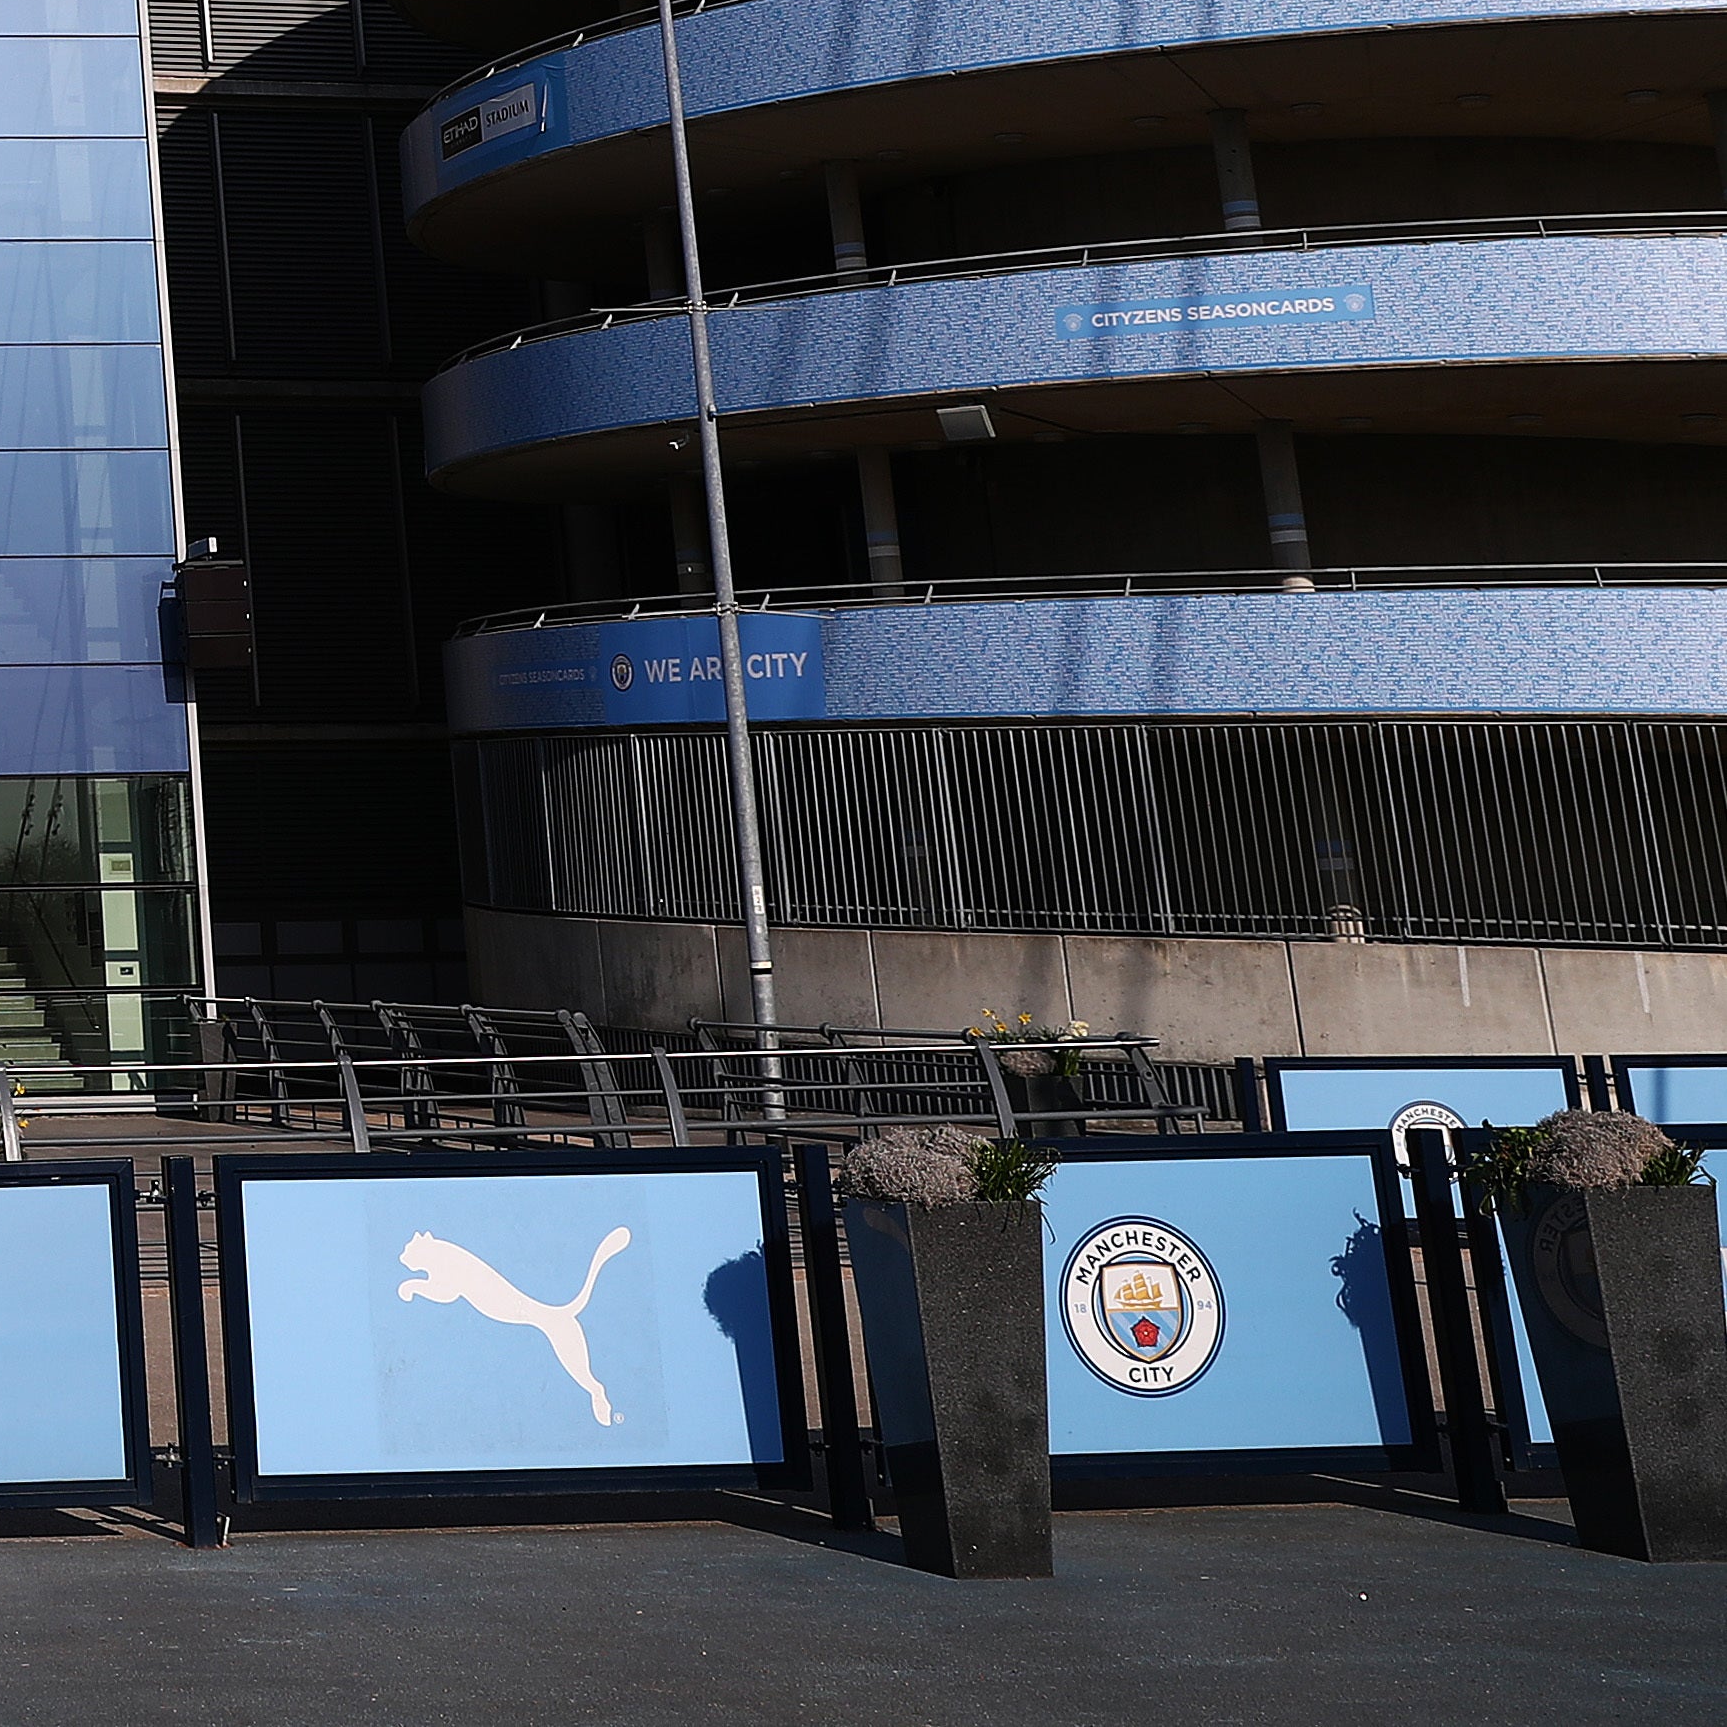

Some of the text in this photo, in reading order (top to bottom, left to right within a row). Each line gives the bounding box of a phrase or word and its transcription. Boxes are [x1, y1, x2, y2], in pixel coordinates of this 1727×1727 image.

[443, 116, 478, 144] ETIHAD
[486, 99, 530, 127] STADIUM
[1091, 297, 1335, 328] CITYZENS SEASONCARDS
[644, 659, 681, 683] WE
[689, 656, 722, 681] AR
[746, 652, 808, 678] CITY
[1396, 1107, 1460, 1133] MANCHESTE
[1076, 1230, 1201, 1285] MANCHESTER
[1073, 1300, 1213, 1314] 18 94
[1128, 1366, 1174, 1383] CITY
